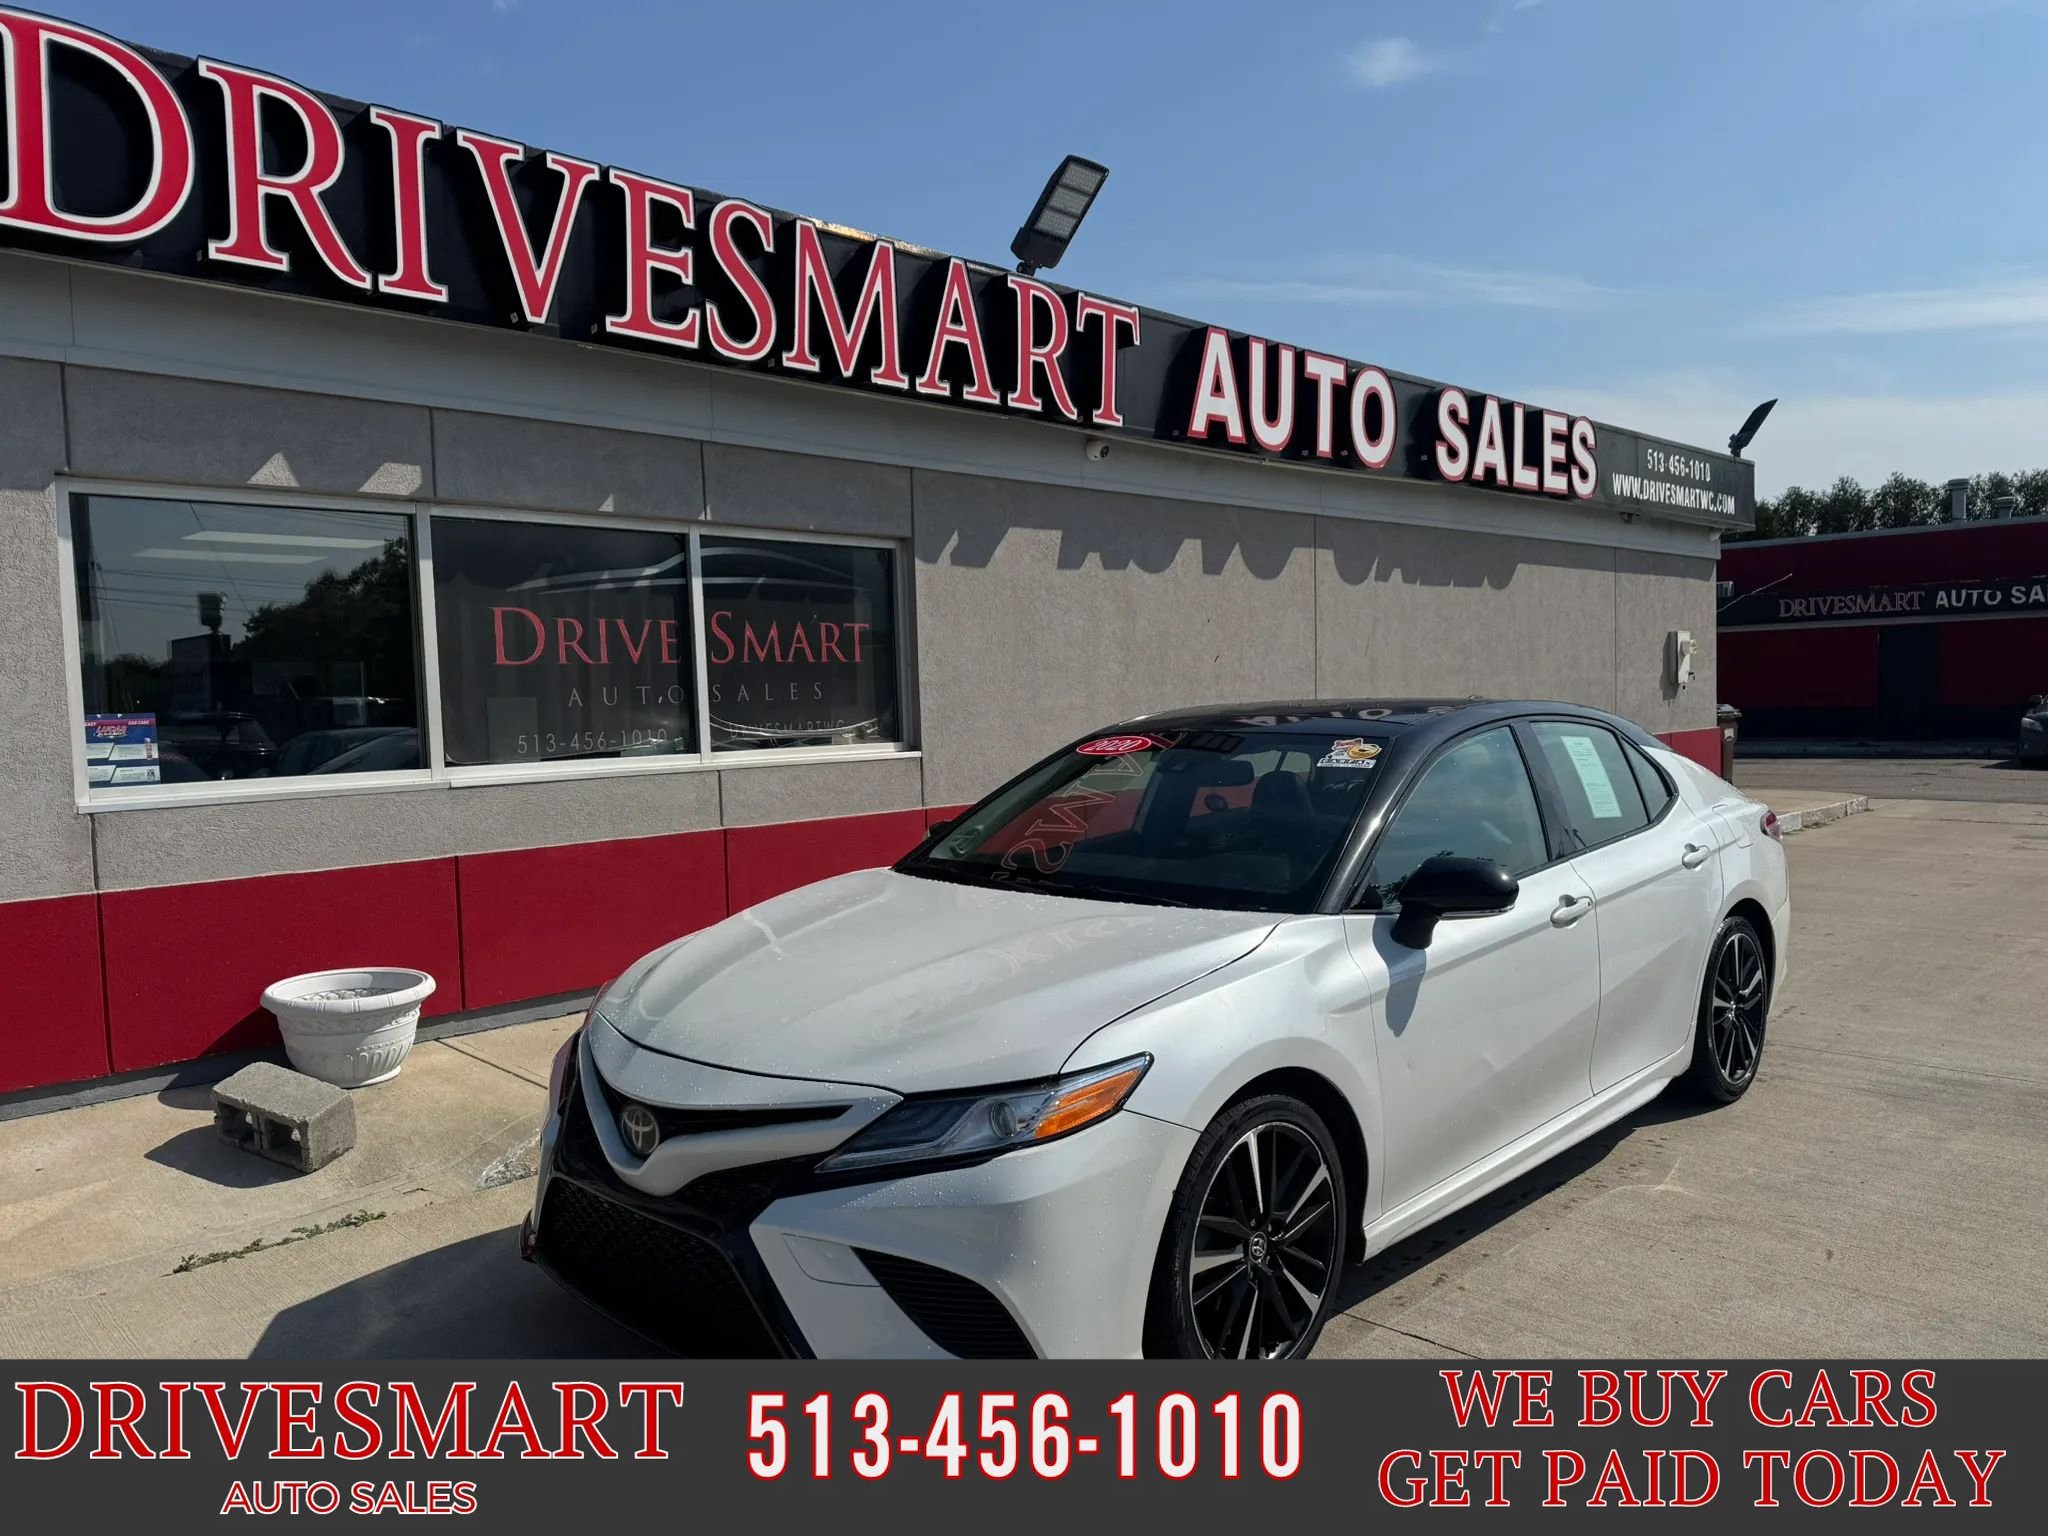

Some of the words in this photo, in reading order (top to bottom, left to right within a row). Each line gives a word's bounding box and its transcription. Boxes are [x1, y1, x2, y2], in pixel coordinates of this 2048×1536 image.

[0, 5, 1141, 427] DRIVESMART
[1187, 326, 1398, 469] AUTO
[1435, 386, 1598, 500] SALES
[1646, 448, 1712, 483] 513-456-1010
[1612, 471, 1736, 516] WWW.DRIVESMARTWC.COM
[1778, 590, 1926, 619] DRIVESMART
[1935, 588, 2003, 609] AUTO
[567, 684, 685, 708] AUTO
[712, 681, 824, 703] SALES
